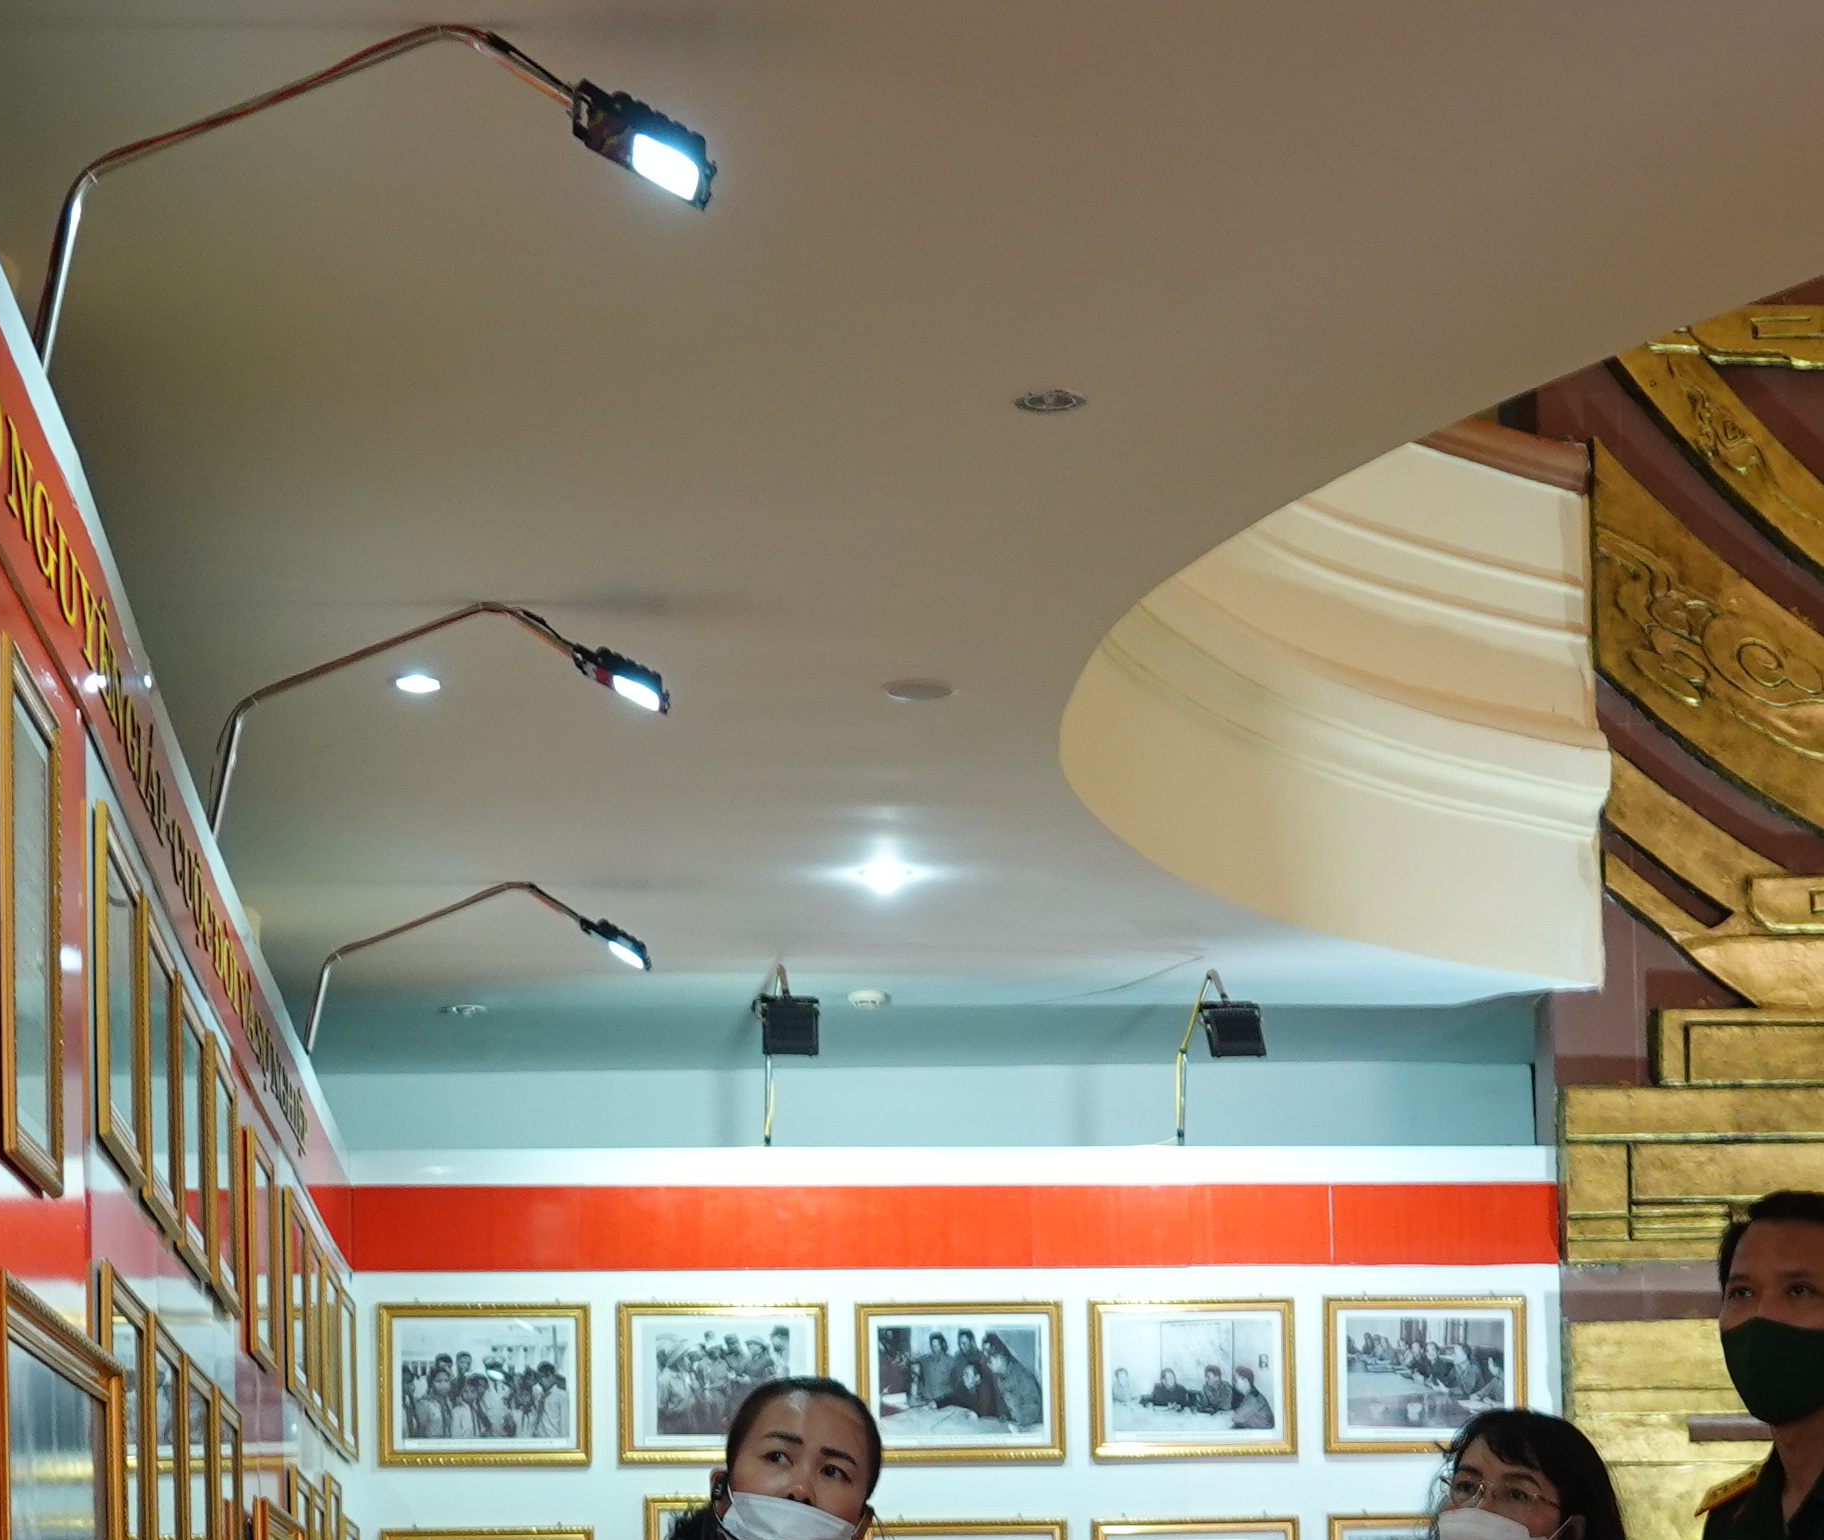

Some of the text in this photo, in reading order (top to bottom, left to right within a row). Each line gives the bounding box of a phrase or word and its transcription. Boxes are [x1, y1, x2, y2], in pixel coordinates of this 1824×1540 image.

[7, 414, 122, 744] NGUYÊN
[123, 694, 166, 846] GIÁP
[171, 818, 213, 955] CUỘC
